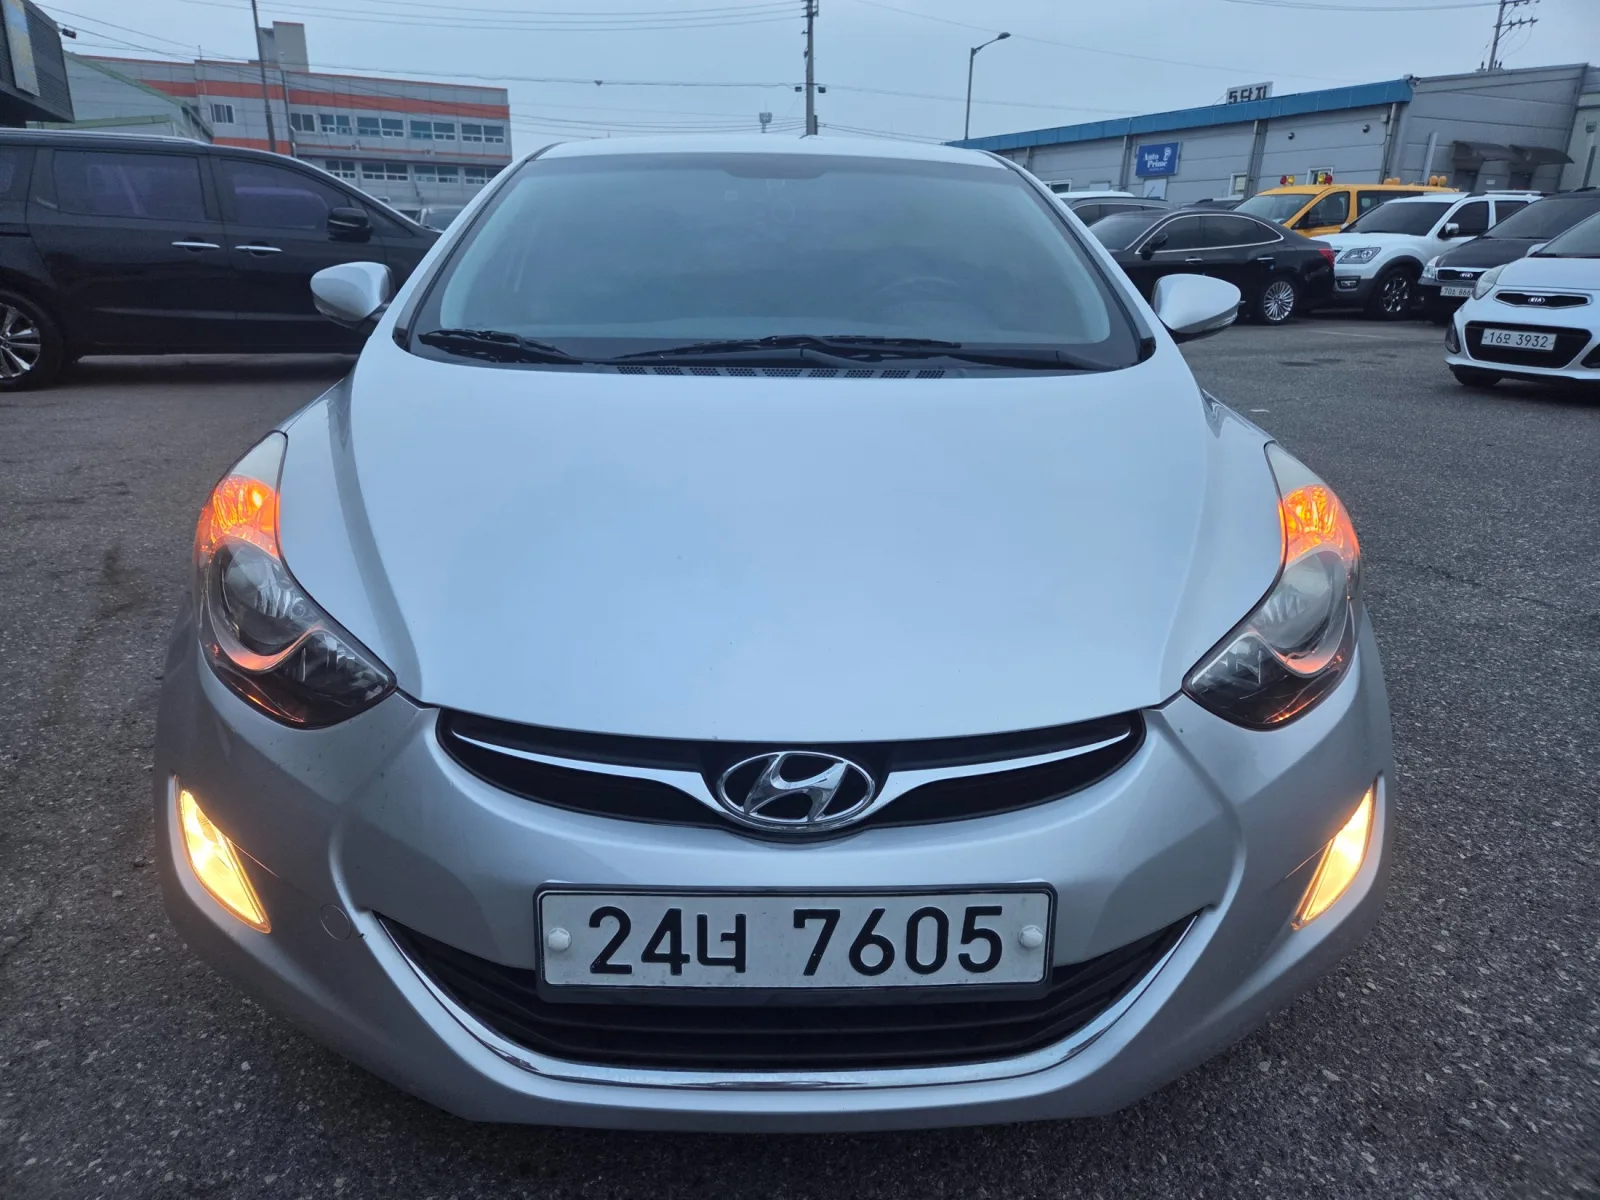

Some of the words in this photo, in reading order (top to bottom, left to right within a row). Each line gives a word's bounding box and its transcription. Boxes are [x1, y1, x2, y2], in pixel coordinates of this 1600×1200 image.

[1144, 152, 1159, 160] Auto
[1147, 160, 1168, 168] Prime
[1516, 334, 1548, 348] 3932
[588, 905, 746, 976] 24너
[793, 905, 1003, 976] 7605
